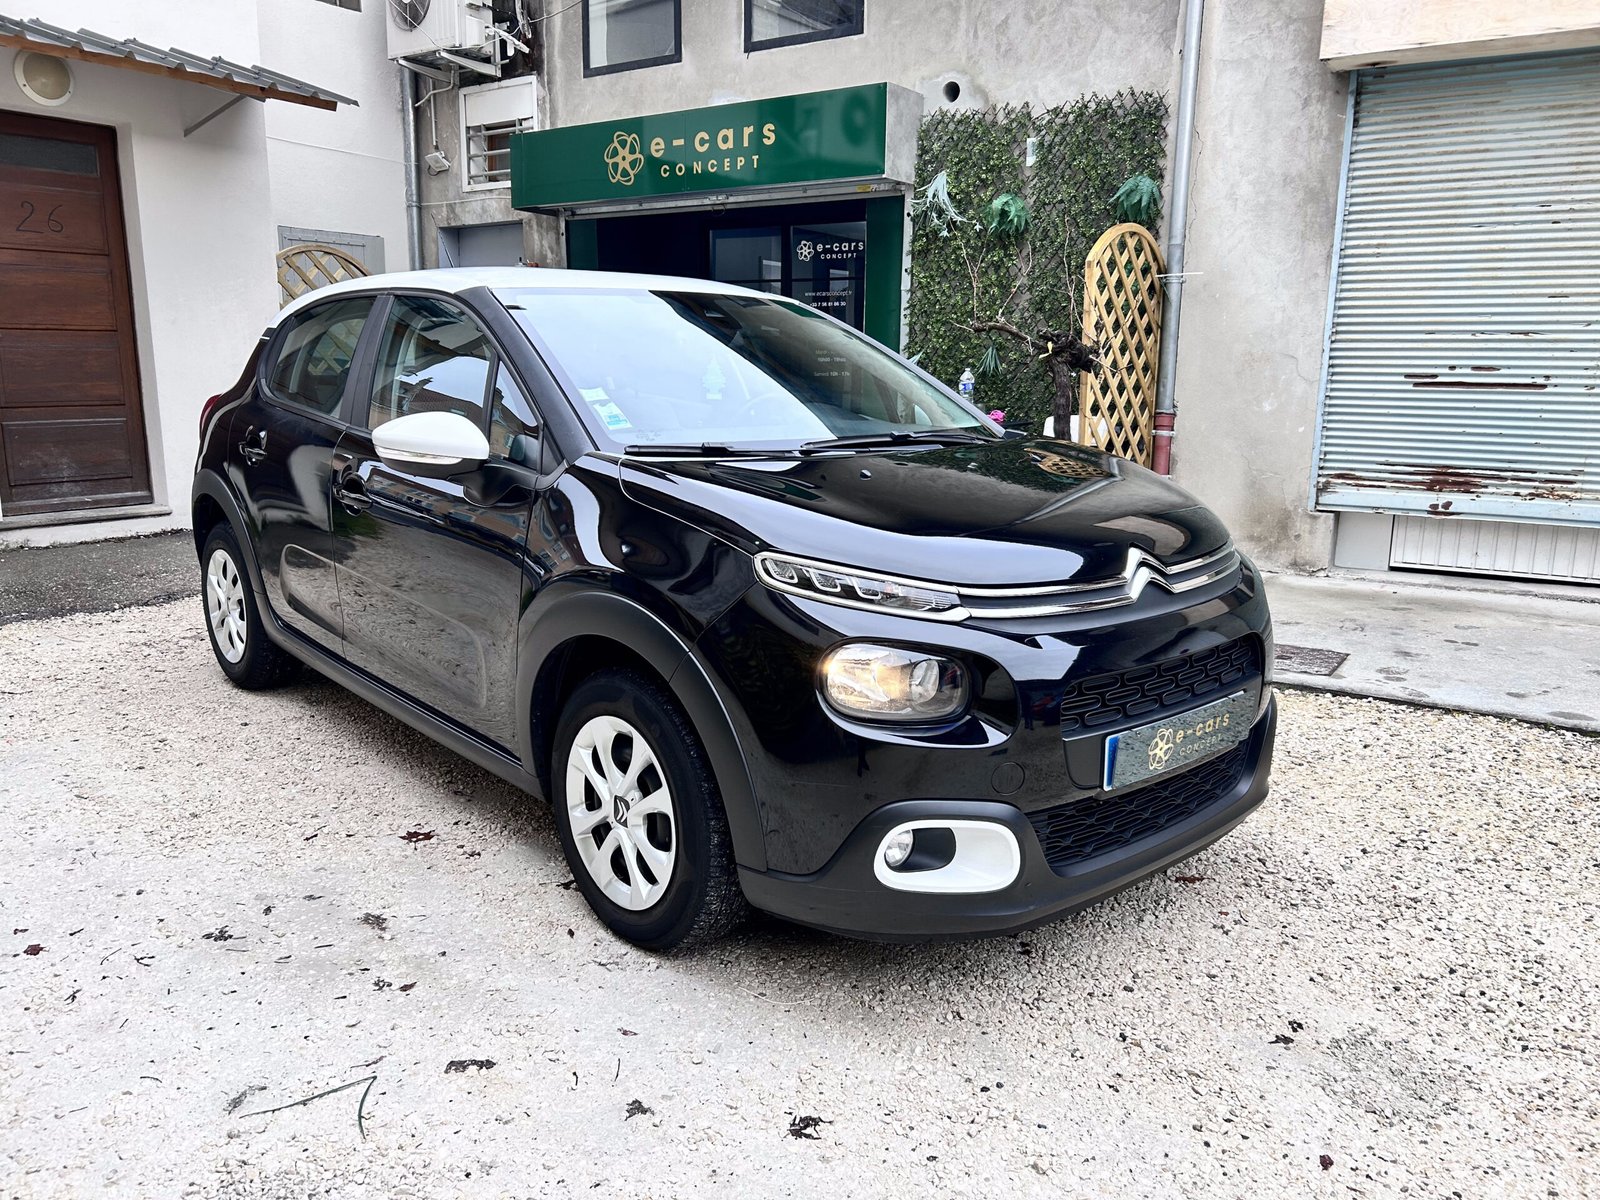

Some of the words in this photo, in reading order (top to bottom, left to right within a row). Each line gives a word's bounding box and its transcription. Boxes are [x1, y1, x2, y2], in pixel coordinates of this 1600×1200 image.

[650, 122, 776, 158] e-cars
[660, 154, 760, 178] CONCEPT
[15, 200, 64, 233] 26
[816, 241, 864, 252] e-cars
[1175, 713, 1230, 743] e-cars
[1179, 733, 1222, 756] CONCEPT
